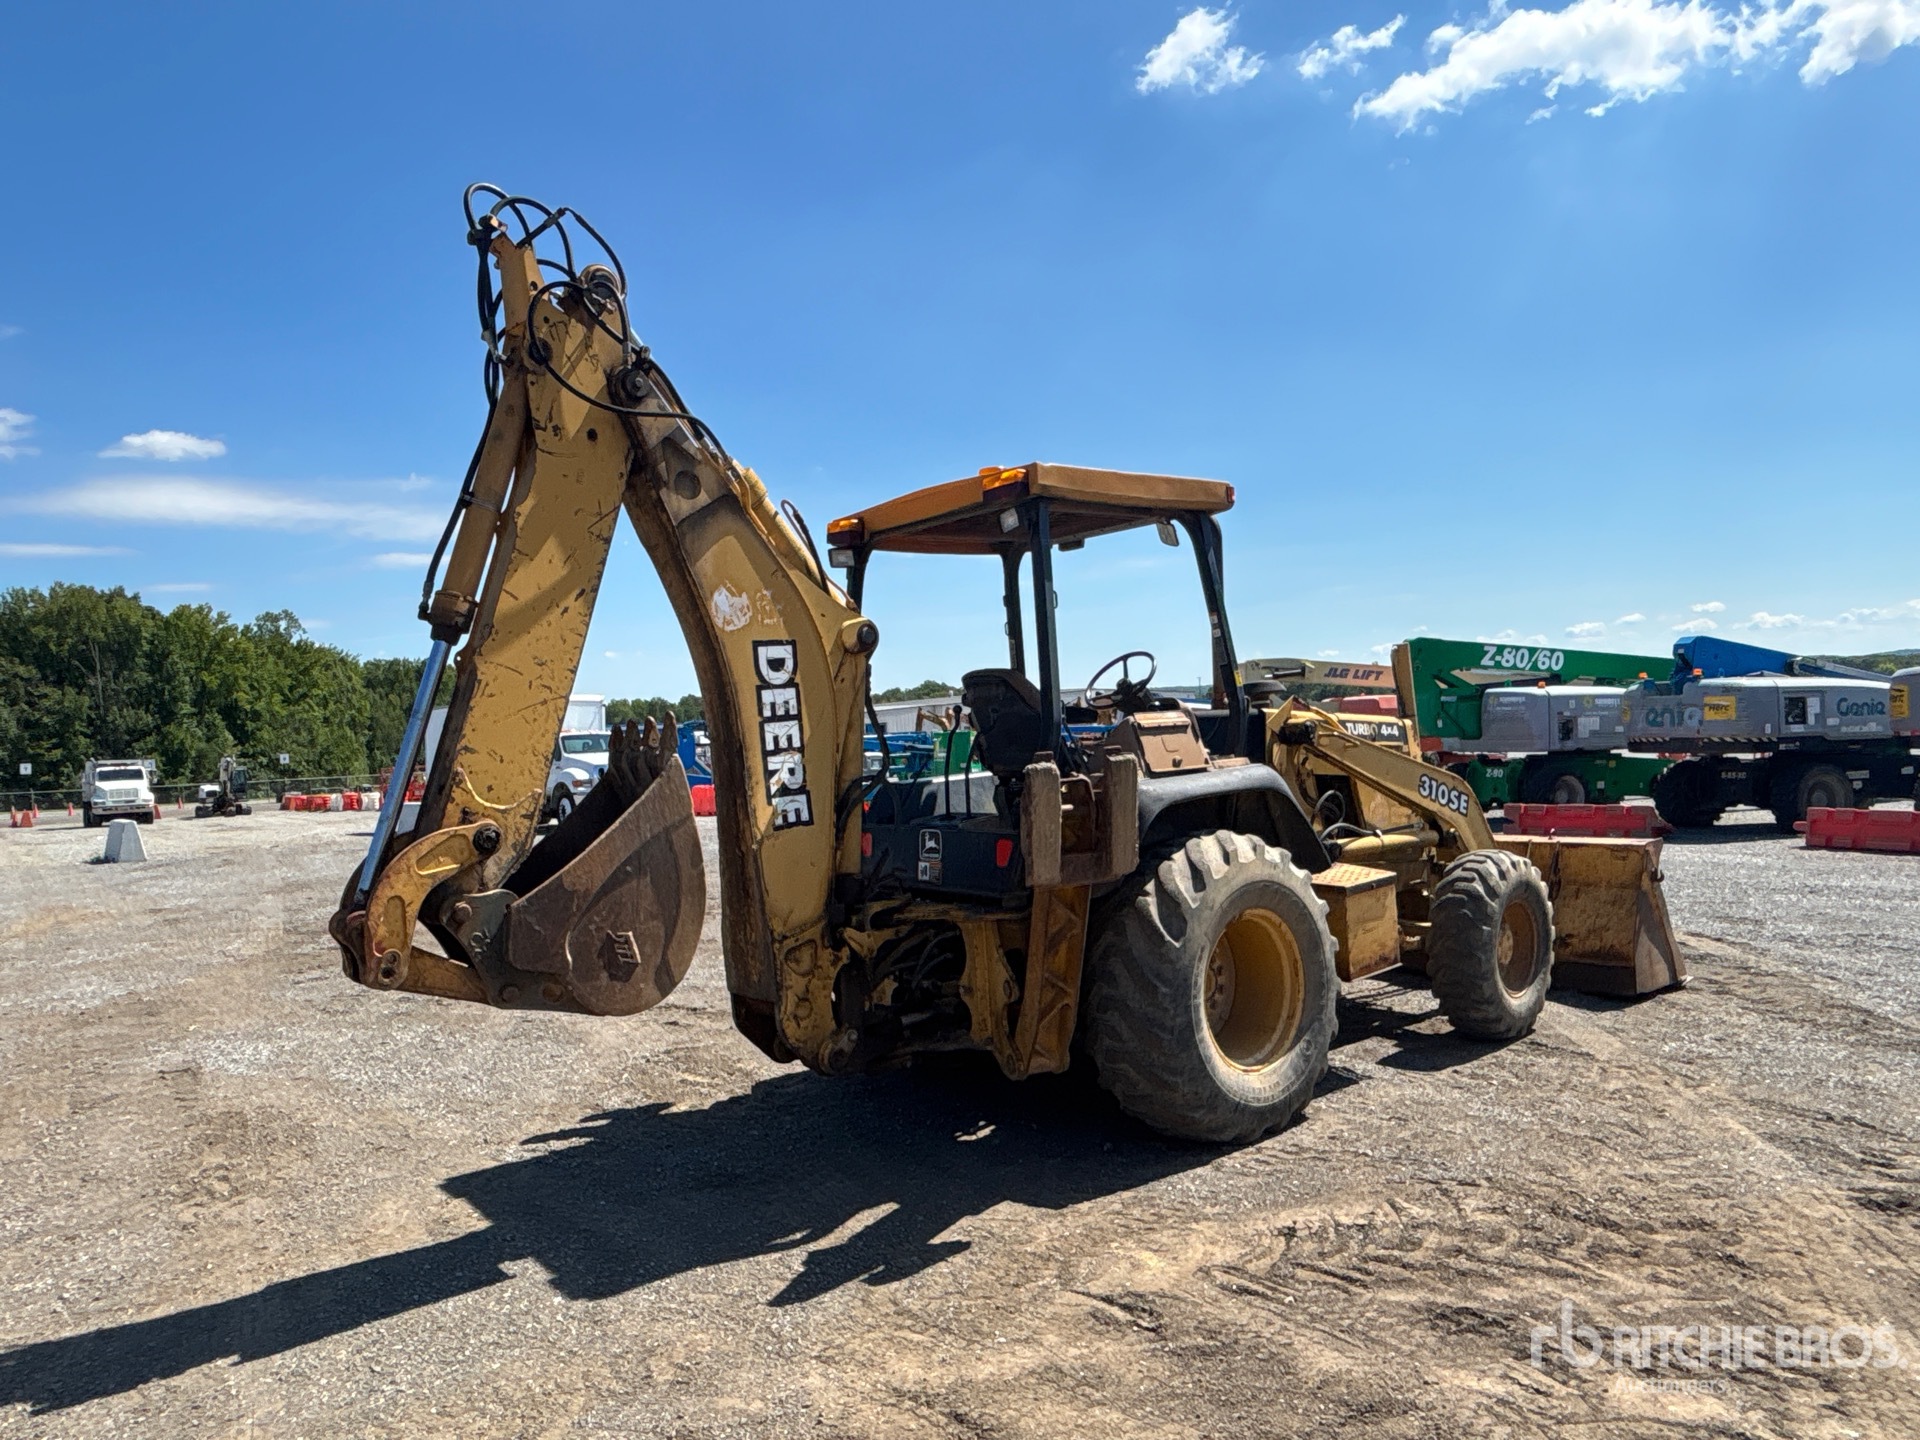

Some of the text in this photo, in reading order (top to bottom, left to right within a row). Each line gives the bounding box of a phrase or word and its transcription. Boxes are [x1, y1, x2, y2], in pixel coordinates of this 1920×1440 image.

[1480, 645, 1565, 671] Z-80/60
[1324, 666, 1384, 681] JLG LIFT
[1836, 697, 1886, 717] Genie
[752, 640, 814, 830] DEERE
[1346, 722, 1399, 738] TURBO 4x4
[1418, 774, 1469, 817] 310SE
